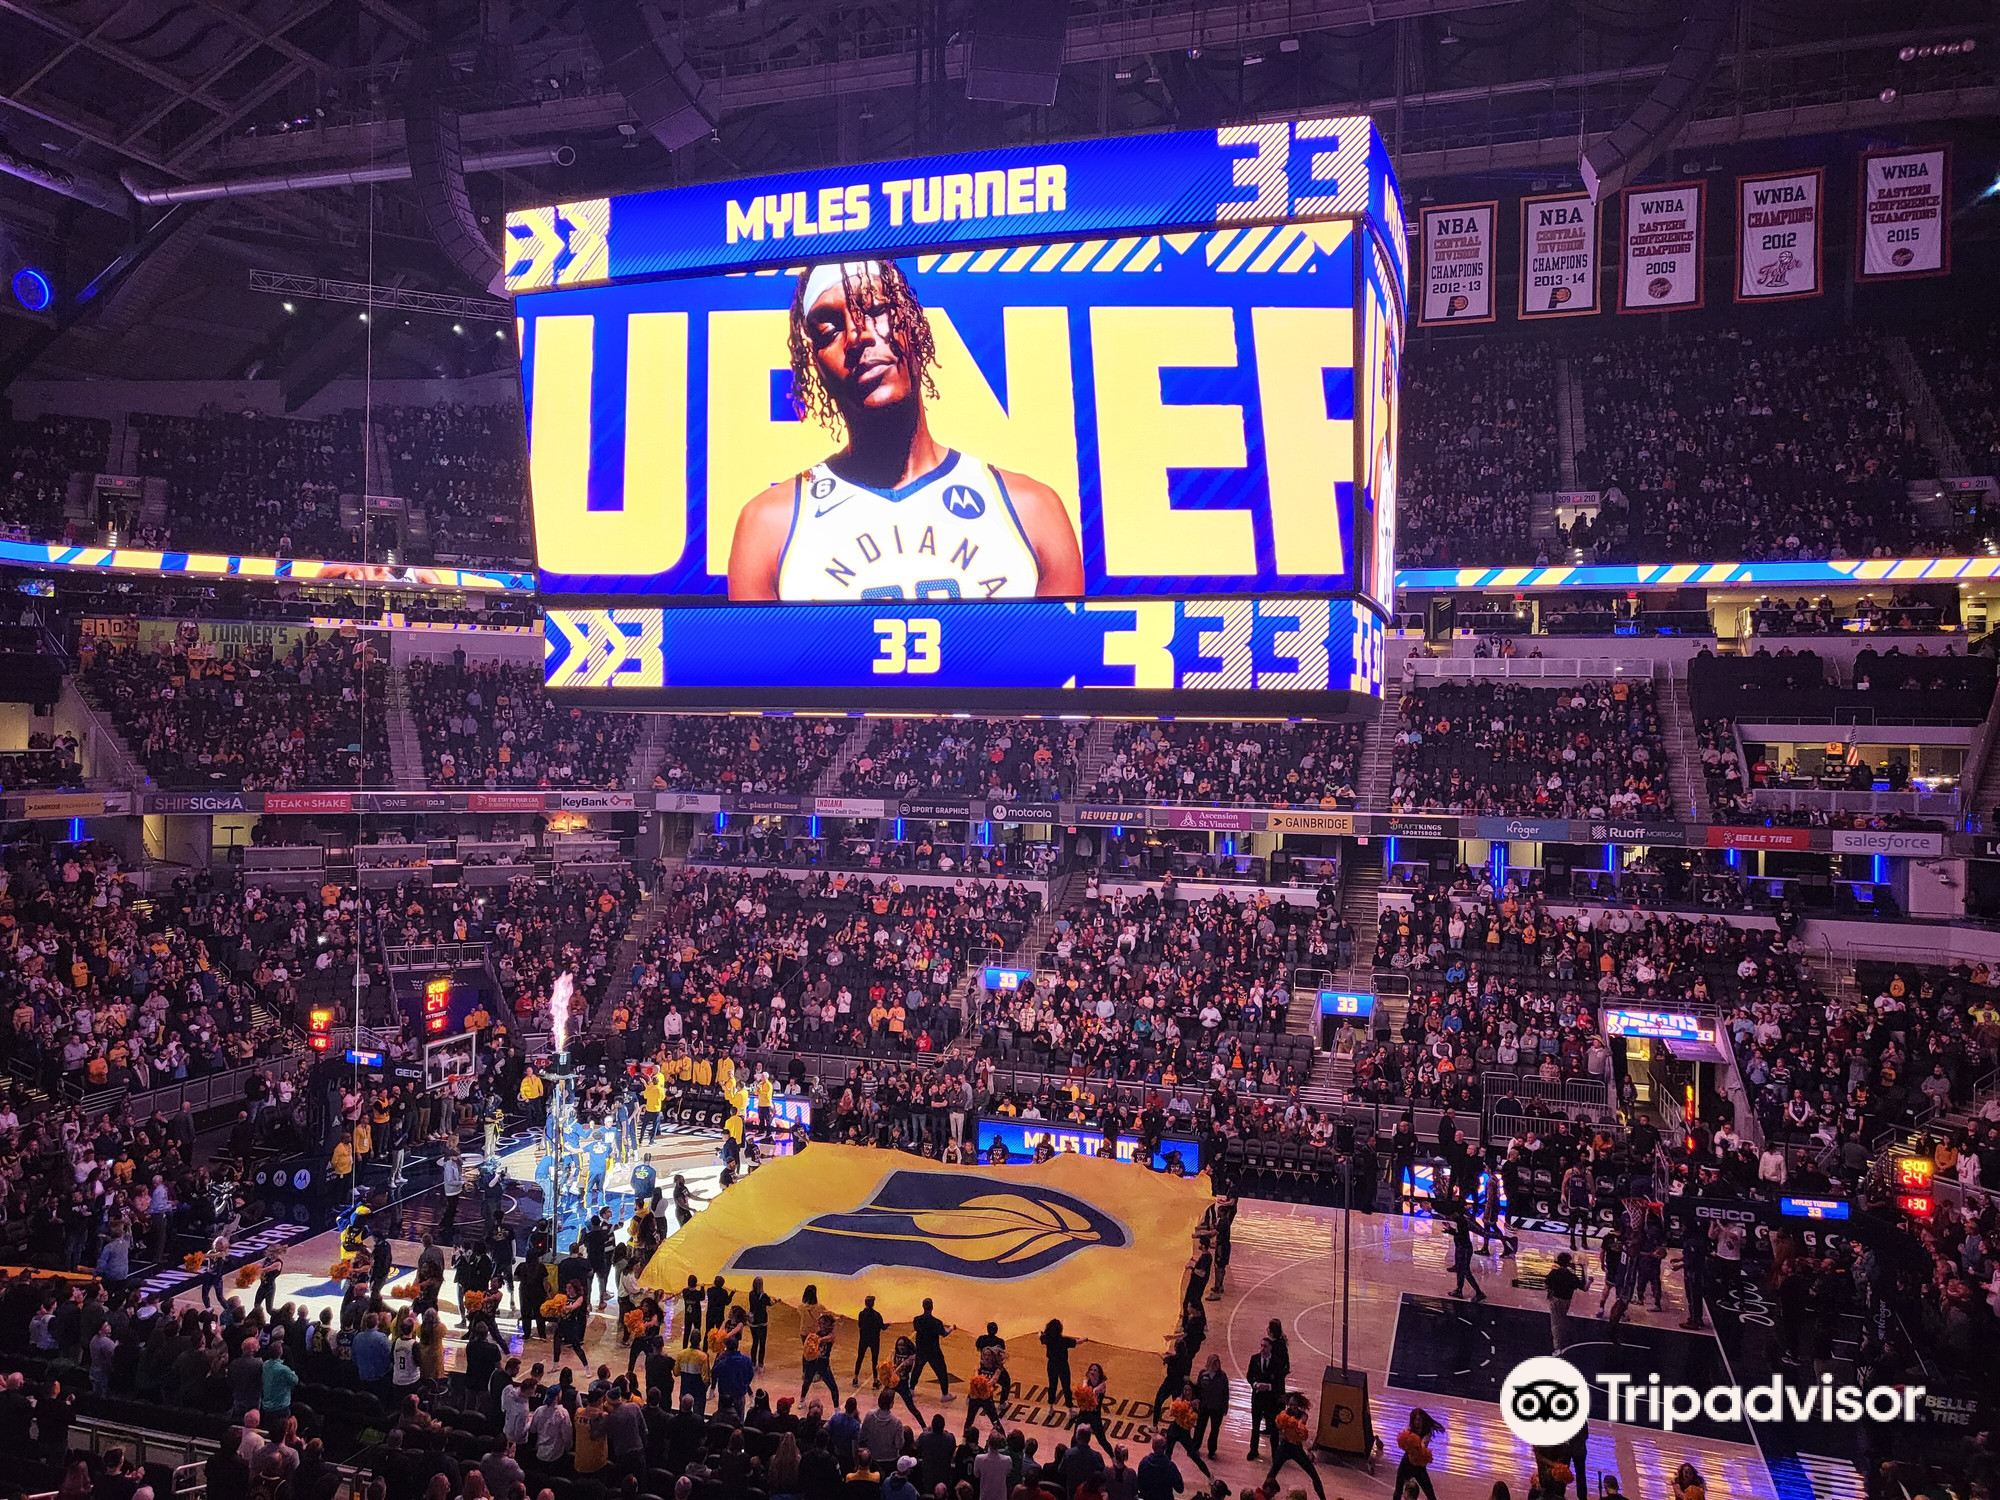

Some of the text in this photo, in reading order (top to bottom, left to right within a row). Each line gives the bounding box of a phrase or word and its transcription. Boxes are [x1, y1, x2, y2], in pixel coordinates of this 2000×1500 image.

[1216, 116, 1371, 220] 33
[1881, 162, 1928, 180] WNBA
[1753, 185, 1806, 205] WNBA
[1877, 184, 1931, 199] EASTERN
[726, 163, 1068, 244] MYLES TURNER
[1641, 199, 1684, 214] WNBA
[1868, 195, 1940, 212] CONFERENCE
[1539, 207, 1584, 226] NBA
[1748, 207, 1813, 228] CHAMPIONS
[1871, 208, 1937, 224] CHAMPIONS
[1437, 217, 1479, 235] NBA
[1638, 219, 1686, 233] EASTERN
[1536, 227, 1586, 242] CENTRAL
[1630, 231, 1694, 246] CONFERENCE
[1762, 232, 1796, 250] 2012
[1887, 227, 1920, 243] 2015
[1434, 236, 1481, 249] CENTRAL
[1537, 239, 1584, 254] DIVISION
[1435, 248, 1480, 261] DIVISION
[1632, 244, 1691, 257] CHAMPIONS
[1532, 254, 1588, 272] CHAMPIONS
[1646, 261, 1676, 275] 2009
[1431, 263, 1483, 279] CHAMPIONS
[210, 624, 287, 645] TURNER'S
[873, 618, 941, 674] 33
[267, 800, 302, 808] STEAK
[311, 800, 347, 808] SHAKE
[562, 797, 608, 808] KeyBank
[750, 802, 773, 810] planet
[816, 800, 842, 808] INDIANA
[911, 805, 934, 814] SPORT
[935, 806, 970, 815] GRAPHICS
[1008, 808, 1052, 818] motorola
[1080, 811, 1133, 822] REVVED UP
[1199, 812, 1238, 820] Ascension
[1285, 817, 1349, 829] GAINBRIDGE
[1506, 817, 1540, 839] Kroger
[1610, 827, 1646, 839] Ruoff
[1735, 834, 1793, 844] BELLE TIRE
[1844, 833, 1930, 851] salesforce
[1000, 972, 1017, 988] 33
[428, 992, 443, 1011] 24
[1337, 996, 1357, 1013] 33
[312, 1019, 324, 1029] 24
[1903, 1170, 1922, 1184] 24
[1695, 1206, 1755, 1222] GEICO
[1808, 1207, 1822, 1218] 33
[228, 1223, 310, 1257] ACERS
[1925, 1395, 1978, 1413] BELLE
[1931, 1410, 1970, 1425] TIRE
